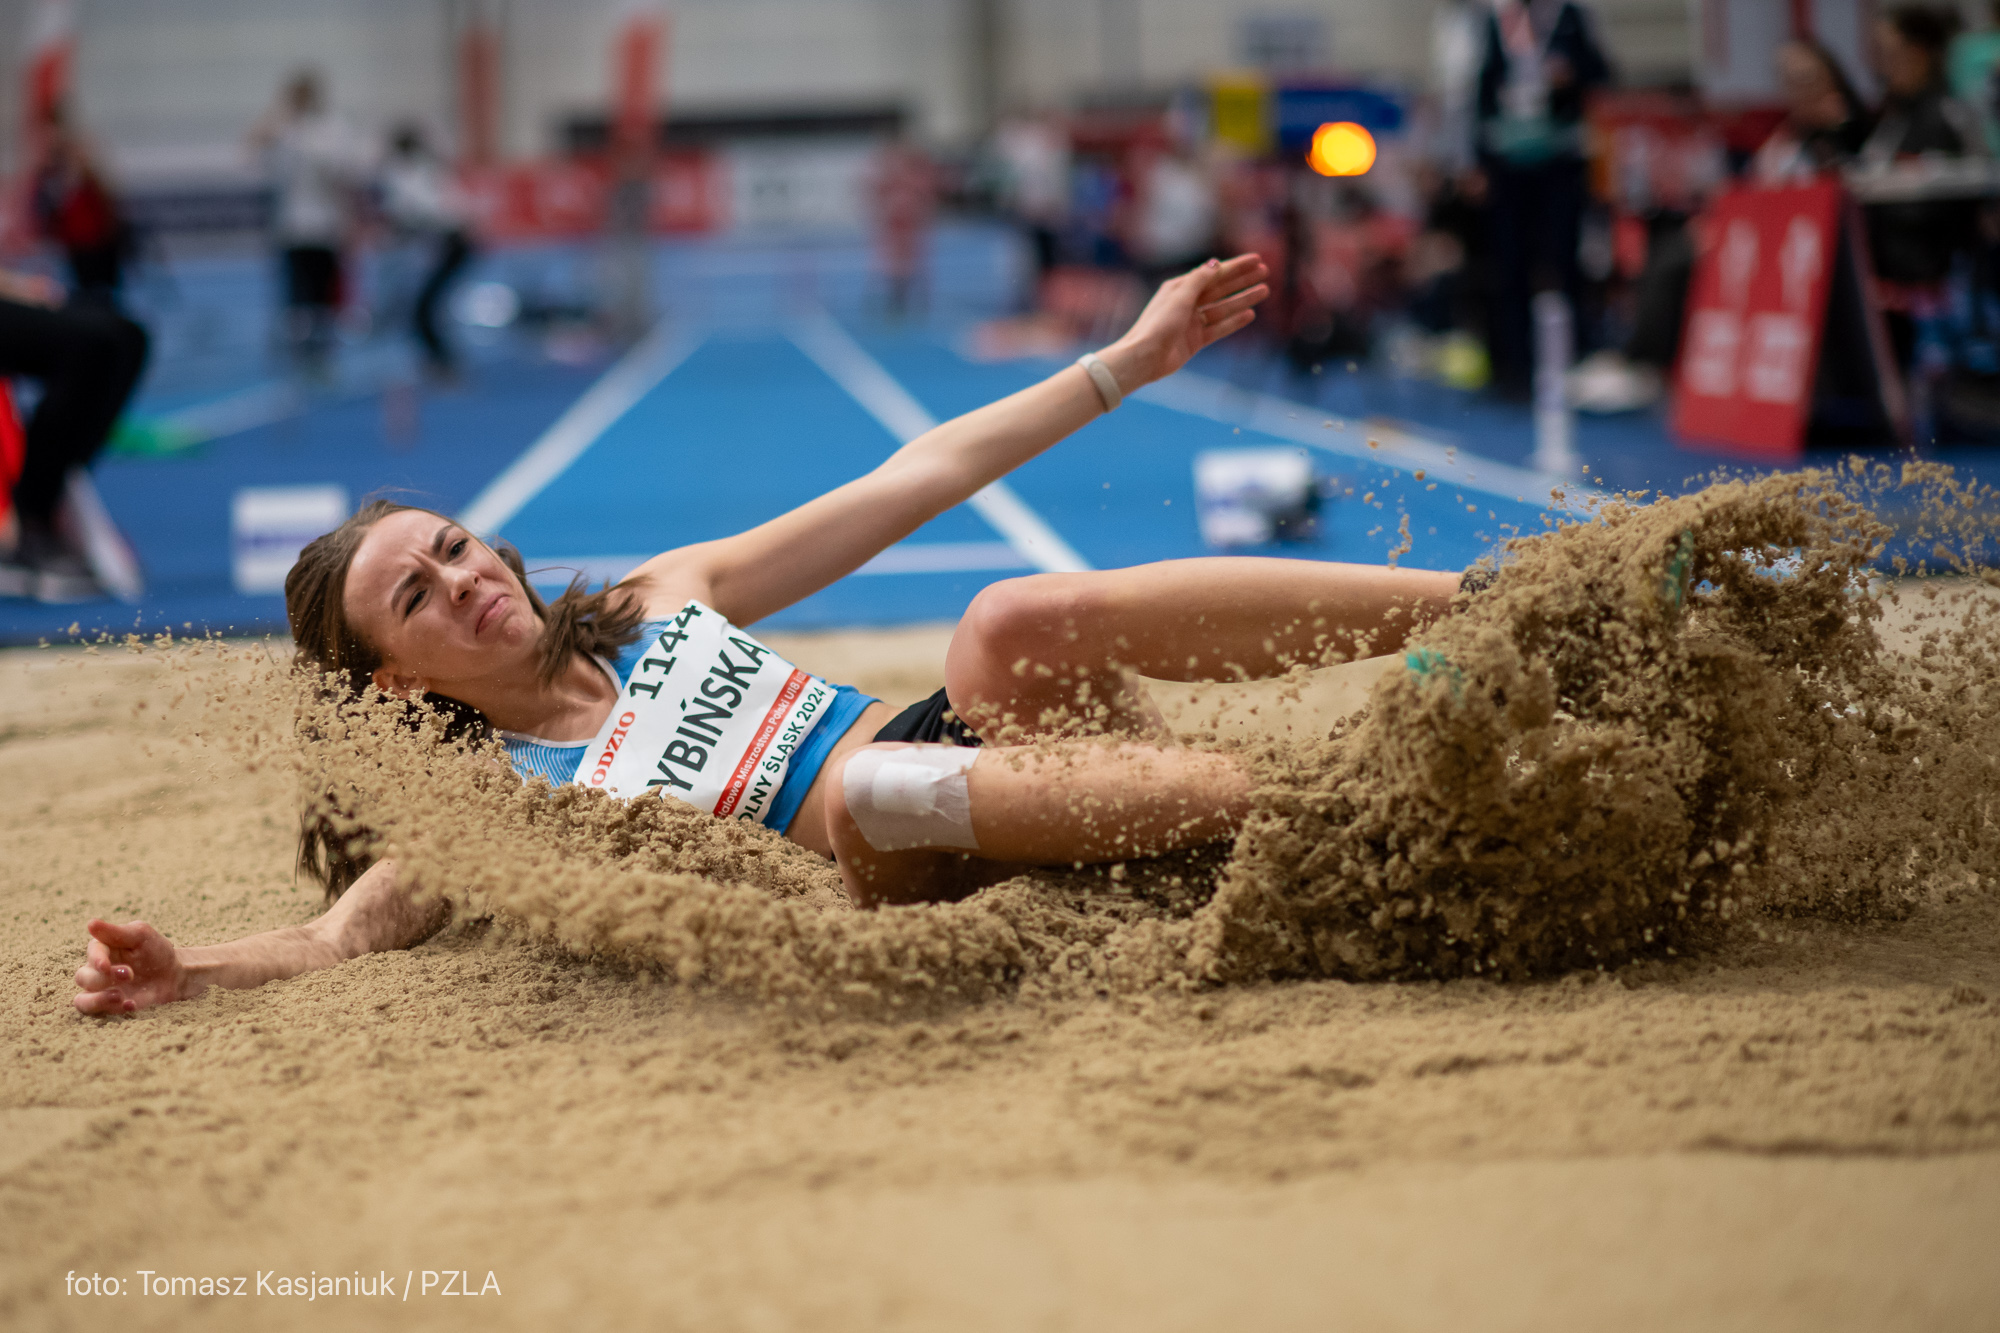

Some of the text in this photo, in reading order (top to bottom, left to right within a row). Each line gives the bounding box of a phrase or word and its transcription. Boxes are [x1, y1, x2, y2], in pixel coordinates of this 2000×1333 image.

[629, 605, 702, 699] 1144
[646, 636, 770, 803] YBIŃSKA
[736, 725, 774, 780] Mistrzostwa
[768, 698, 790, 725] Polski
[784, 681, 800, 699] U18
[763, 721, 805, 773] ŚLĄSK
[796, 687, 826, 722] 2024
